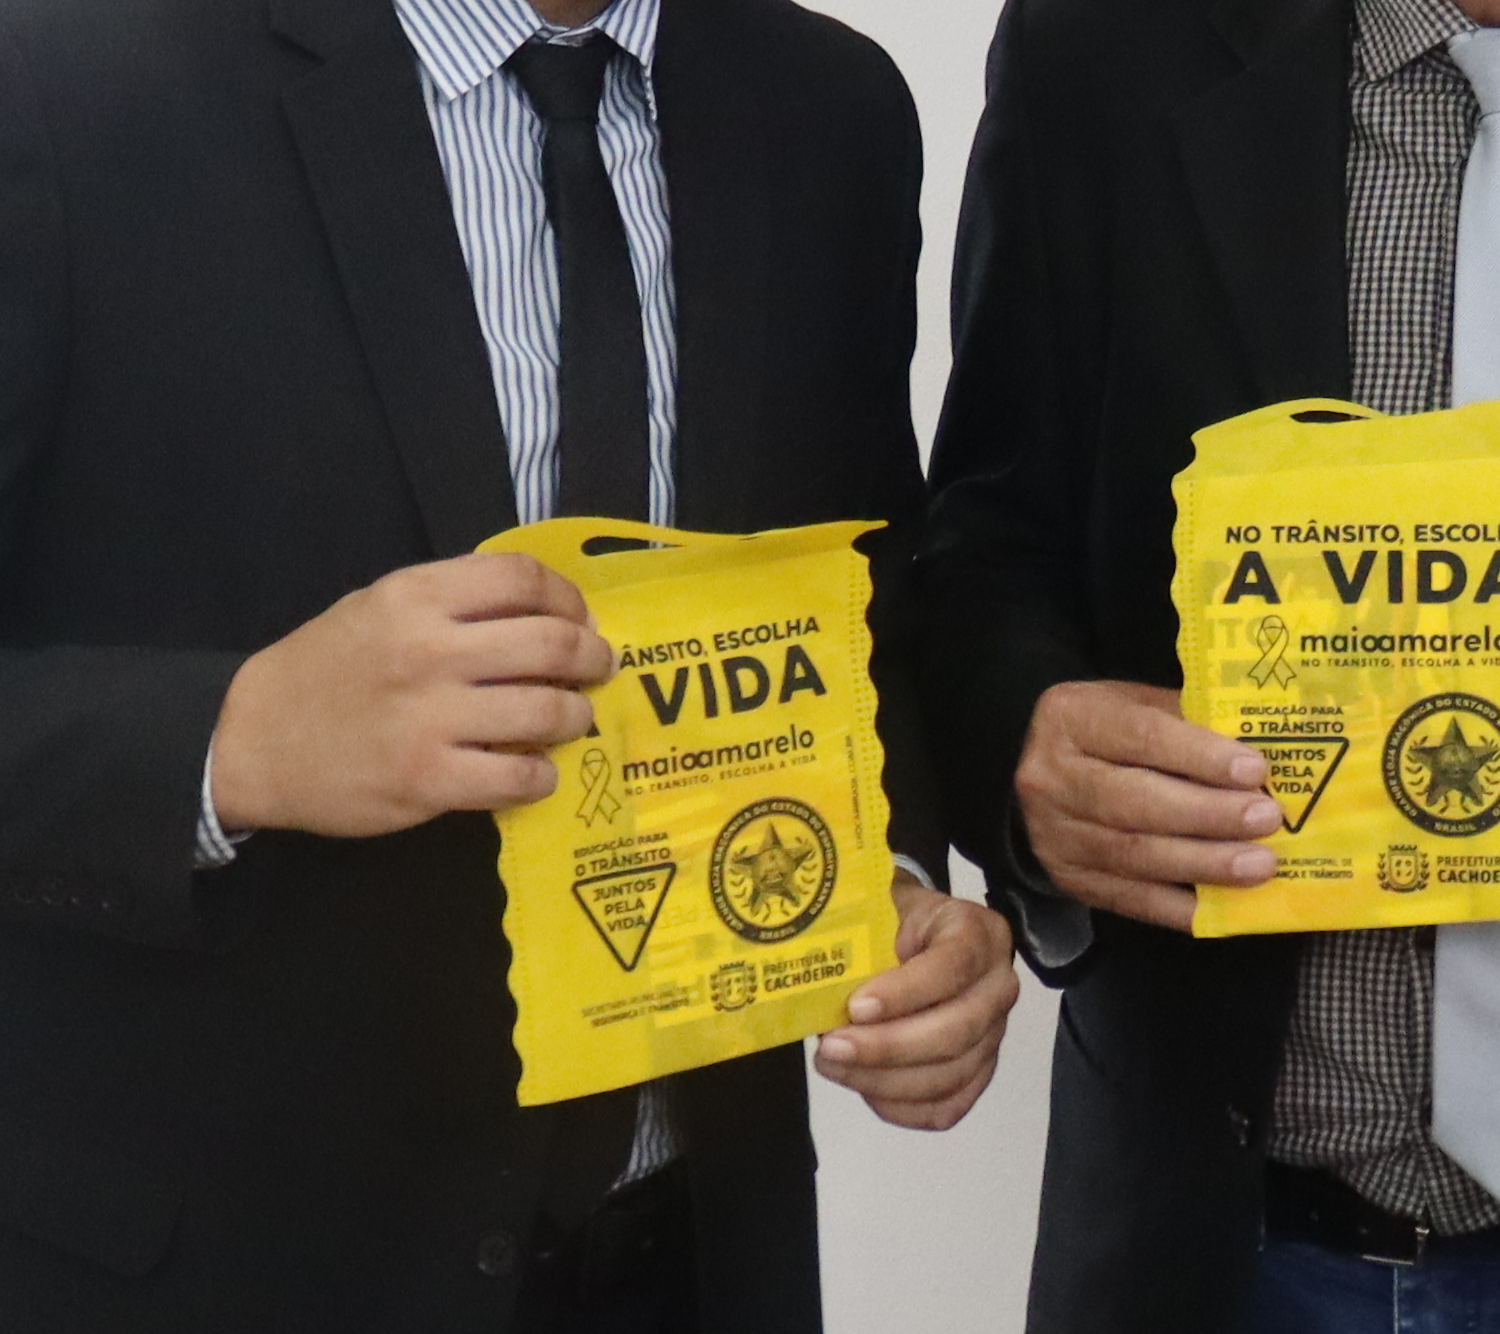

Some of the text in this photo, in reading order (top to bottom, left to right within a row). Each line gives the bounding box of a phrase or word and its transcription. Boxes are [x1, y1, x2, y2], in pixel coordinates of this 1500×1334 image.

[1225, 526, 1261, 544] NO
[1271, 519, 1404, 546] TRÂNSITO,
[1223, 550, 1281, 604] A
[713, 617, 820, 652] ESCOLHA
[1301, 658, 1320, 668] NO
[1402, 657, 1461, 668] ESCOLHA
[1467, 657, 1476, 667] A
[639, 644, 827, 727] VIDA
[1310, 706, 1344, 715] PARA
[1240, 715, 1344, 734] O TRÂNSITO
[1271, 765, 1314, 779] PELA
[575, 847, 671, 877] O TRÂNSITO
[593, 878, 656, 903] JUNTOS
[604, 897, 645, 917] PELA
[764, 962, 846, 993] CACHOEIRO
